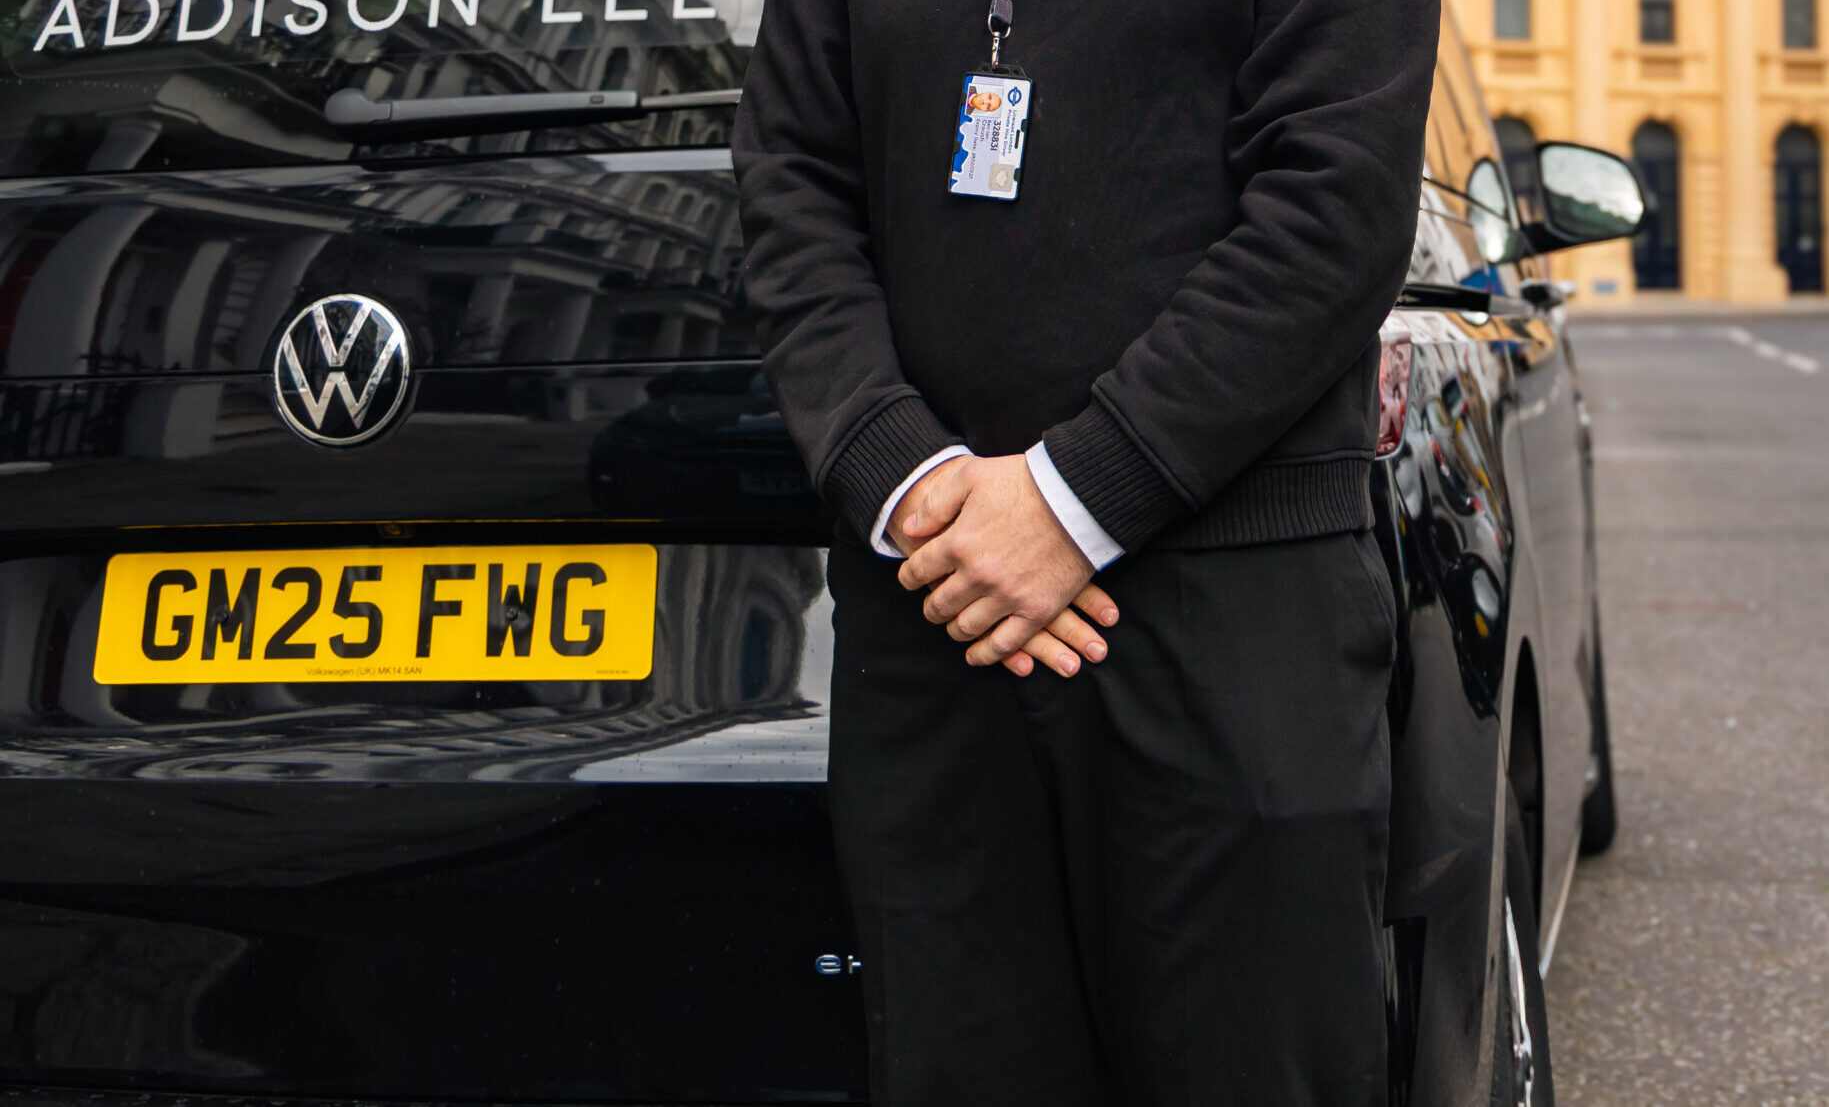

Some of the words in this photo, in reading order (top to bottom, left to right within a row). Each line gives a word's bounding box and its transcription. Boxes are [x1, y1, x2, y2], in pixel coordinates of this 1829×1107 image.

[141, 565, 383, 661] GM25
[415, 562, 607, 658] FWG
[306, 667, 354, 677] Volkswagen
[378, 666, 402, 675] MK14
